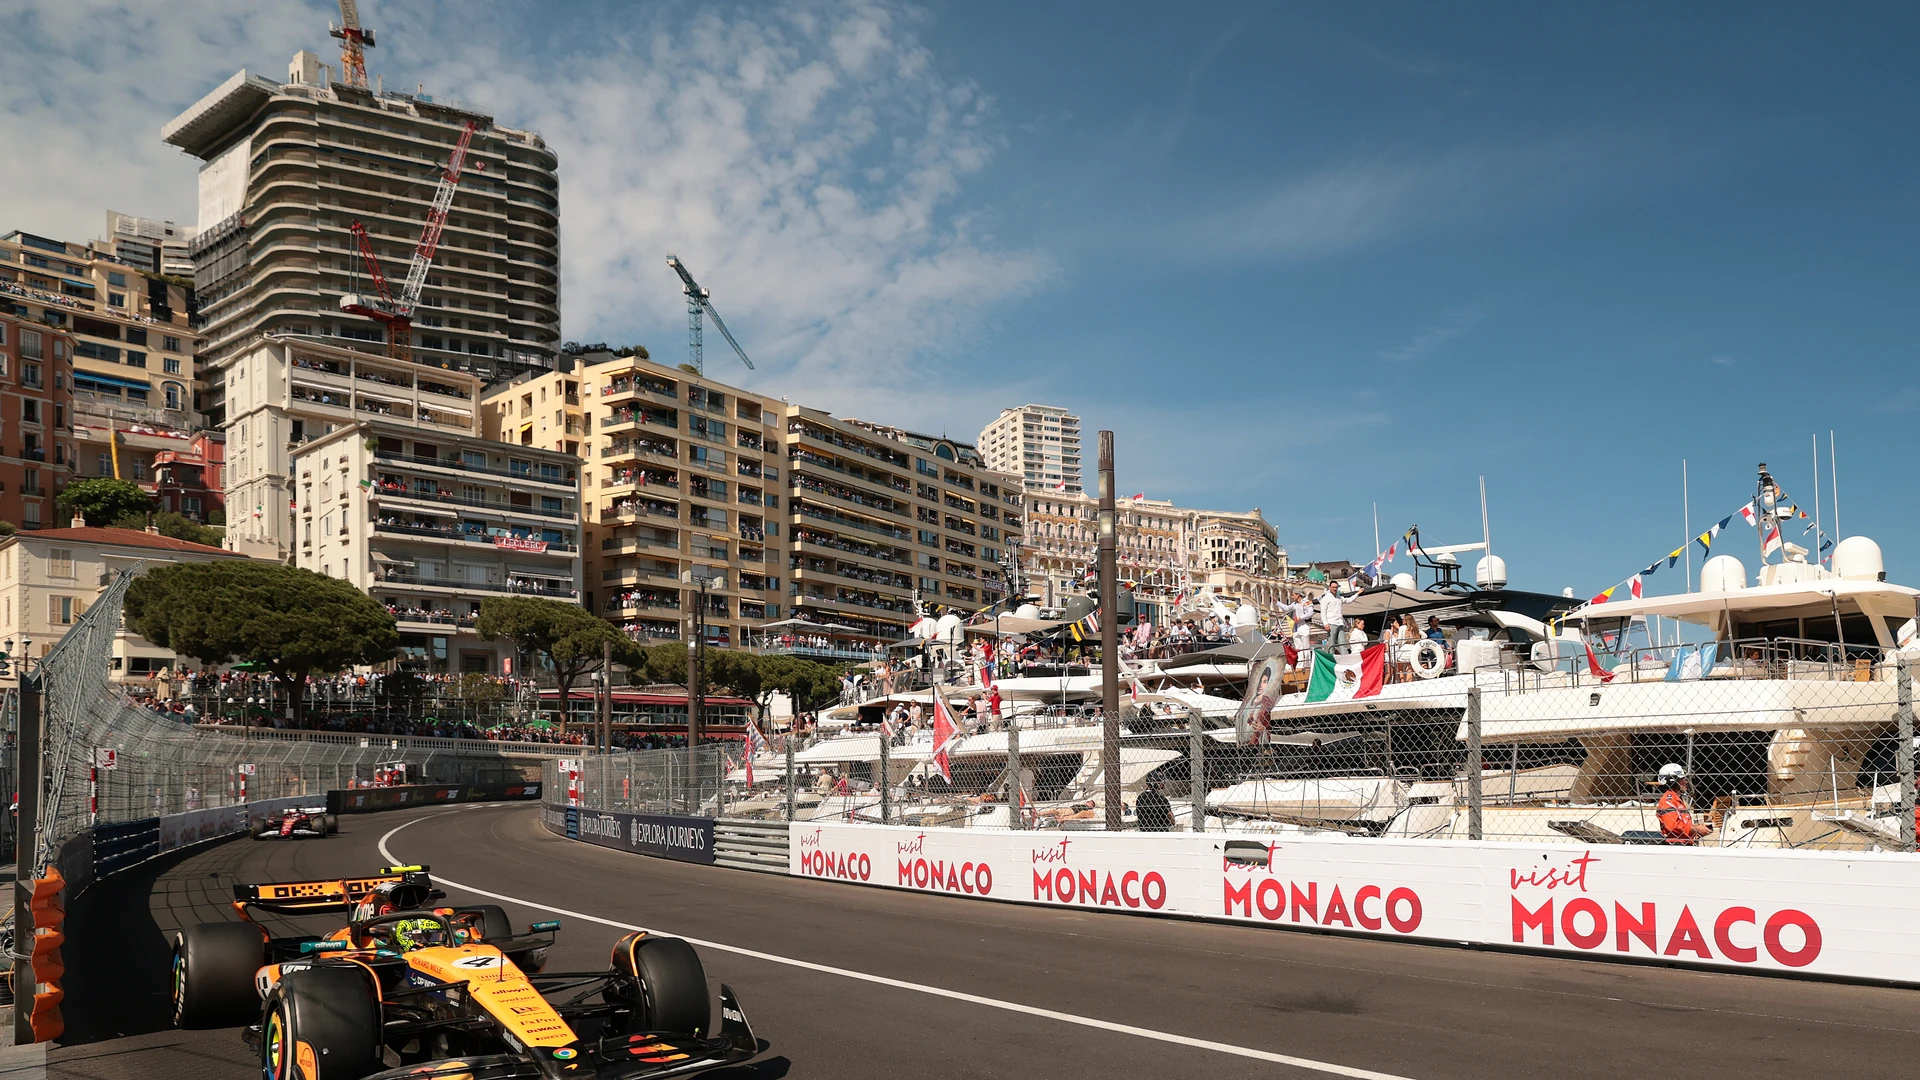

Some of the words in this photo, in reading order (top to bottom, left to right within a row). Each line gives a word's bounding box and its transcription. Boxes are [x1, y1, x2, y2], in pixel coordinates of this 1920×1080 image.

[503, 538, 541, 549] LECLERC
[584, 817, 601, 835] EXPLORA
[600, 819, 621, 840] JOURNEYS
[638, 823, 666, 845] EXPLORA
[665, 825, 705, 851] JOURNEYS
[800, 826, 822, 848] visit
[897, 831, 926, 855] visit
[1032, 835, 1072, 864] visit
[801, 850, 871, 881] MONACO
[898, 858, 993, 895] MONACO
[1510, 850, 1602, 892] visit
[274, 884, 323, 897] OKX
[1033, 867, 1167, 909] MONACO
[1223, 876, 1423, 933] MONACO
[1511, 894, 1823, 967] MONACO
[314, 941, 342, 949] allwyn
[462, 957, 496, 967] 4
[520, 1018, 556, 1026] FxPro
